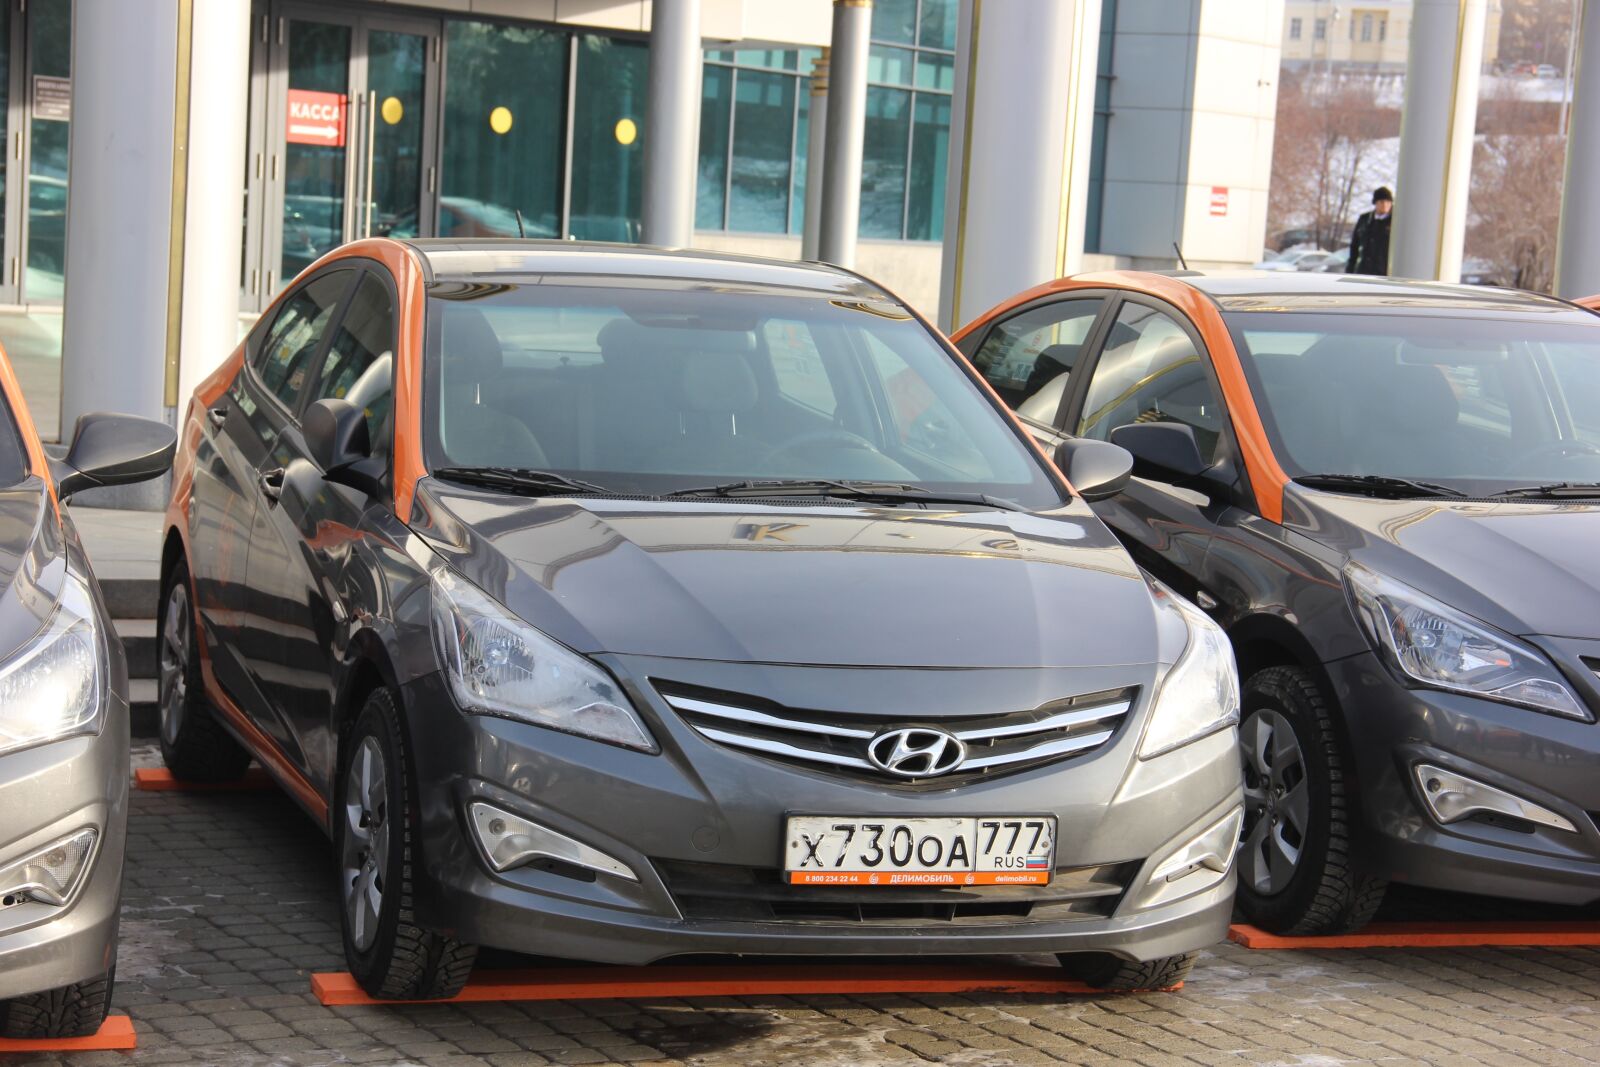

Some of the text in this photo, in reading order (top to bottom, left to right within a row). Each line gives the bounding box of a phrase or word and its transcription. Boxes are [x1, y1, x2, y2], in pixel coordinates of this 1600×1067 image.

[290, 101, 341, 121] КАССА
[800, 821, 1044, 868] Х730ОА 777
[994, 856, 1025, 868] RUS
[890, 874, 954, 884] ДЕЛИМОБИЛЬ
